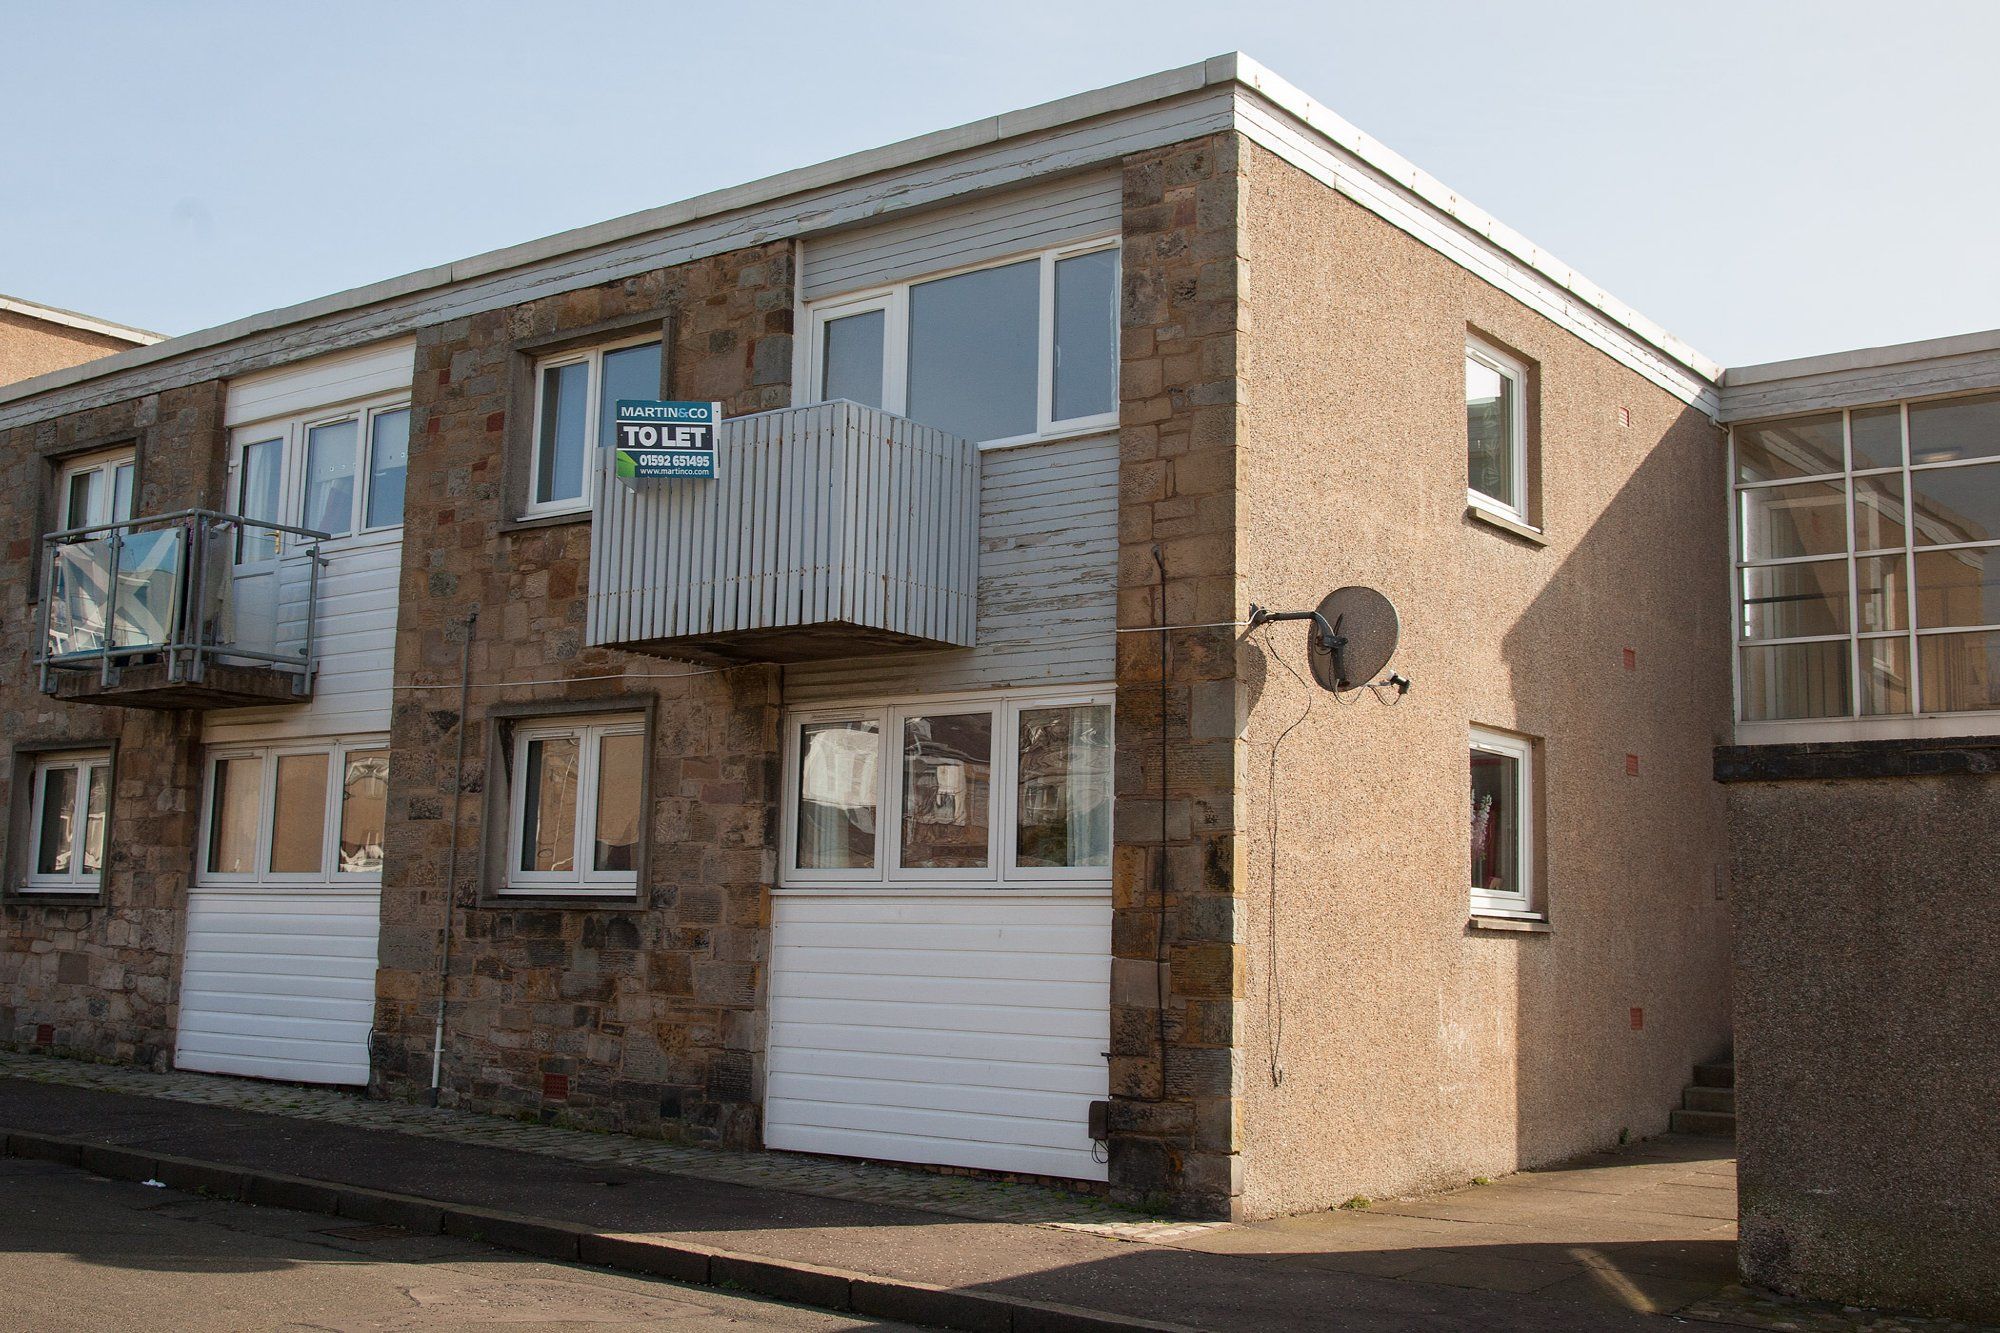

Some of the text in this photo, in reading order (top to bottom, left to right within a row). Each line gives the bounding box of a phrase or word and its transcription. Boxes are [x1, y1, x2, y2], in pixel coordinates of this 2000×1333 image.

[621, 406, 708, 419] MARTIN&CO
[623, 426, 706, 448] TO LET
[640, 454, 710, 467] 01592 651495
